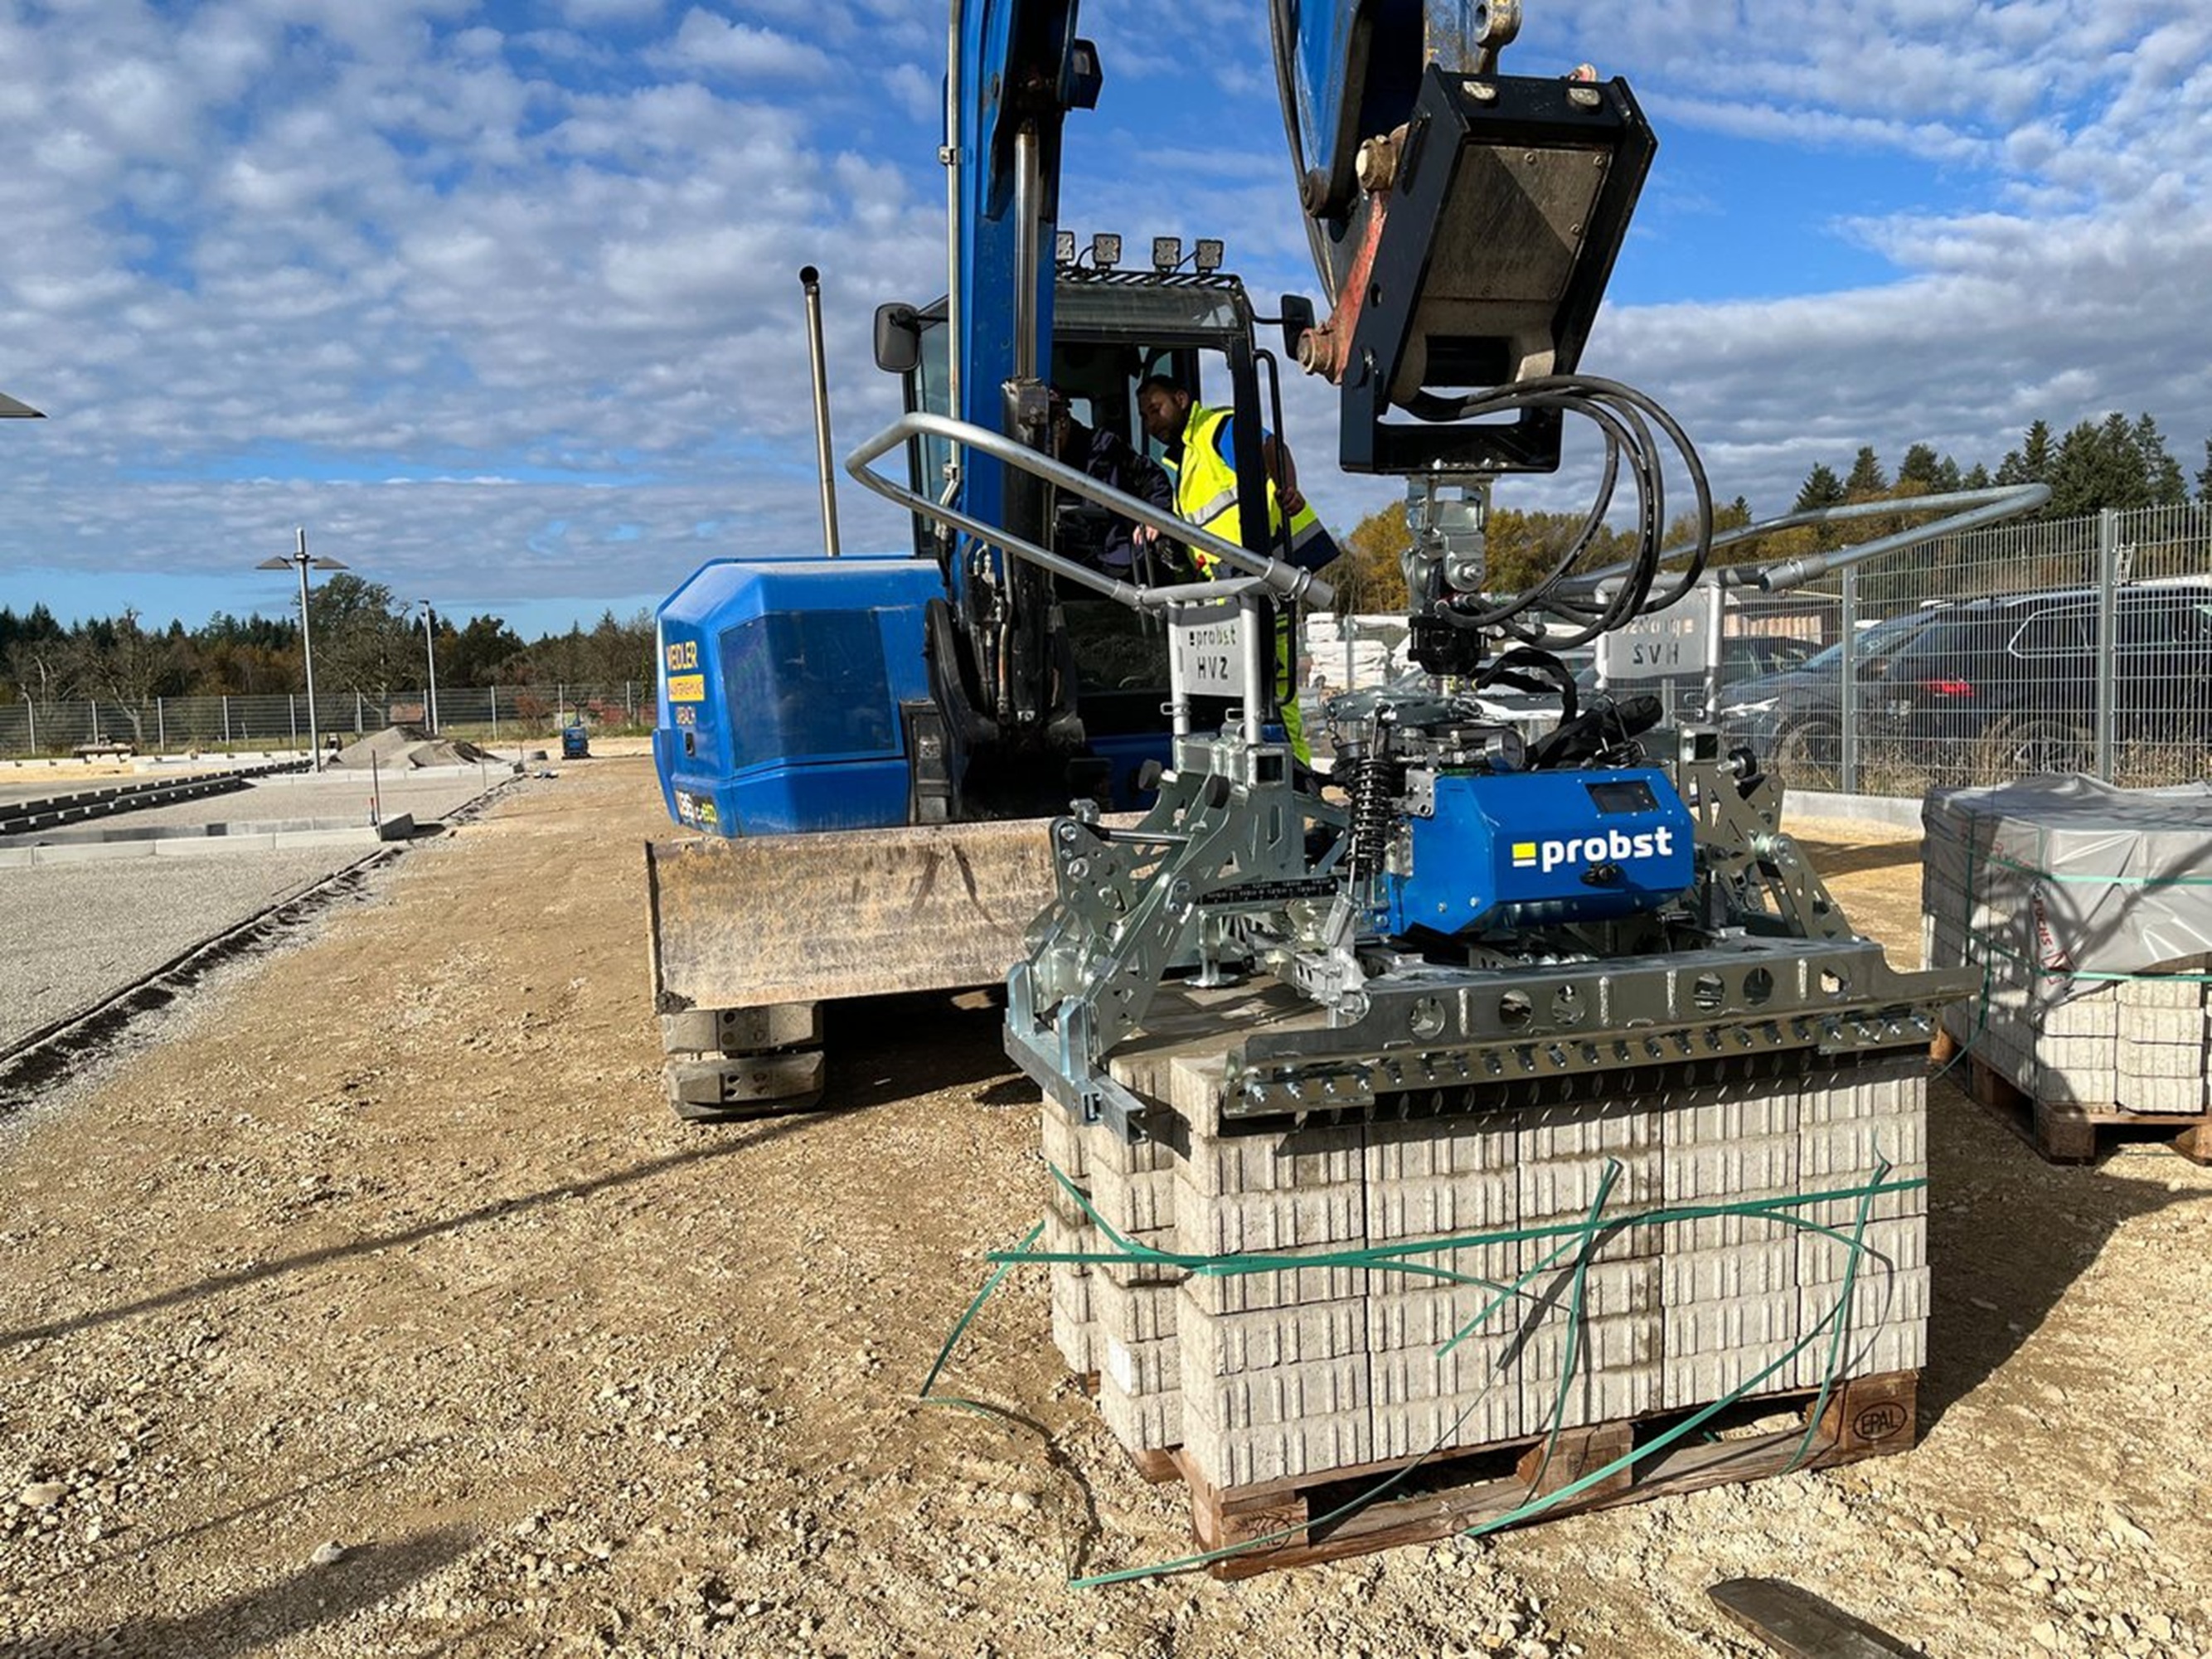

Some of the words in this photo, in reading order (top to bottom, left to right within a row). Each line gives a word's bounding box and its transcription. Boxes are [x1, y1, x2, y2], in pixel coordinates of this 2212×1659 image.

[1196, 627, 1236, 649] probst
[1542, 827, 1673, 873] probst
[1860, 1409, 1899, 1435] EPAL
